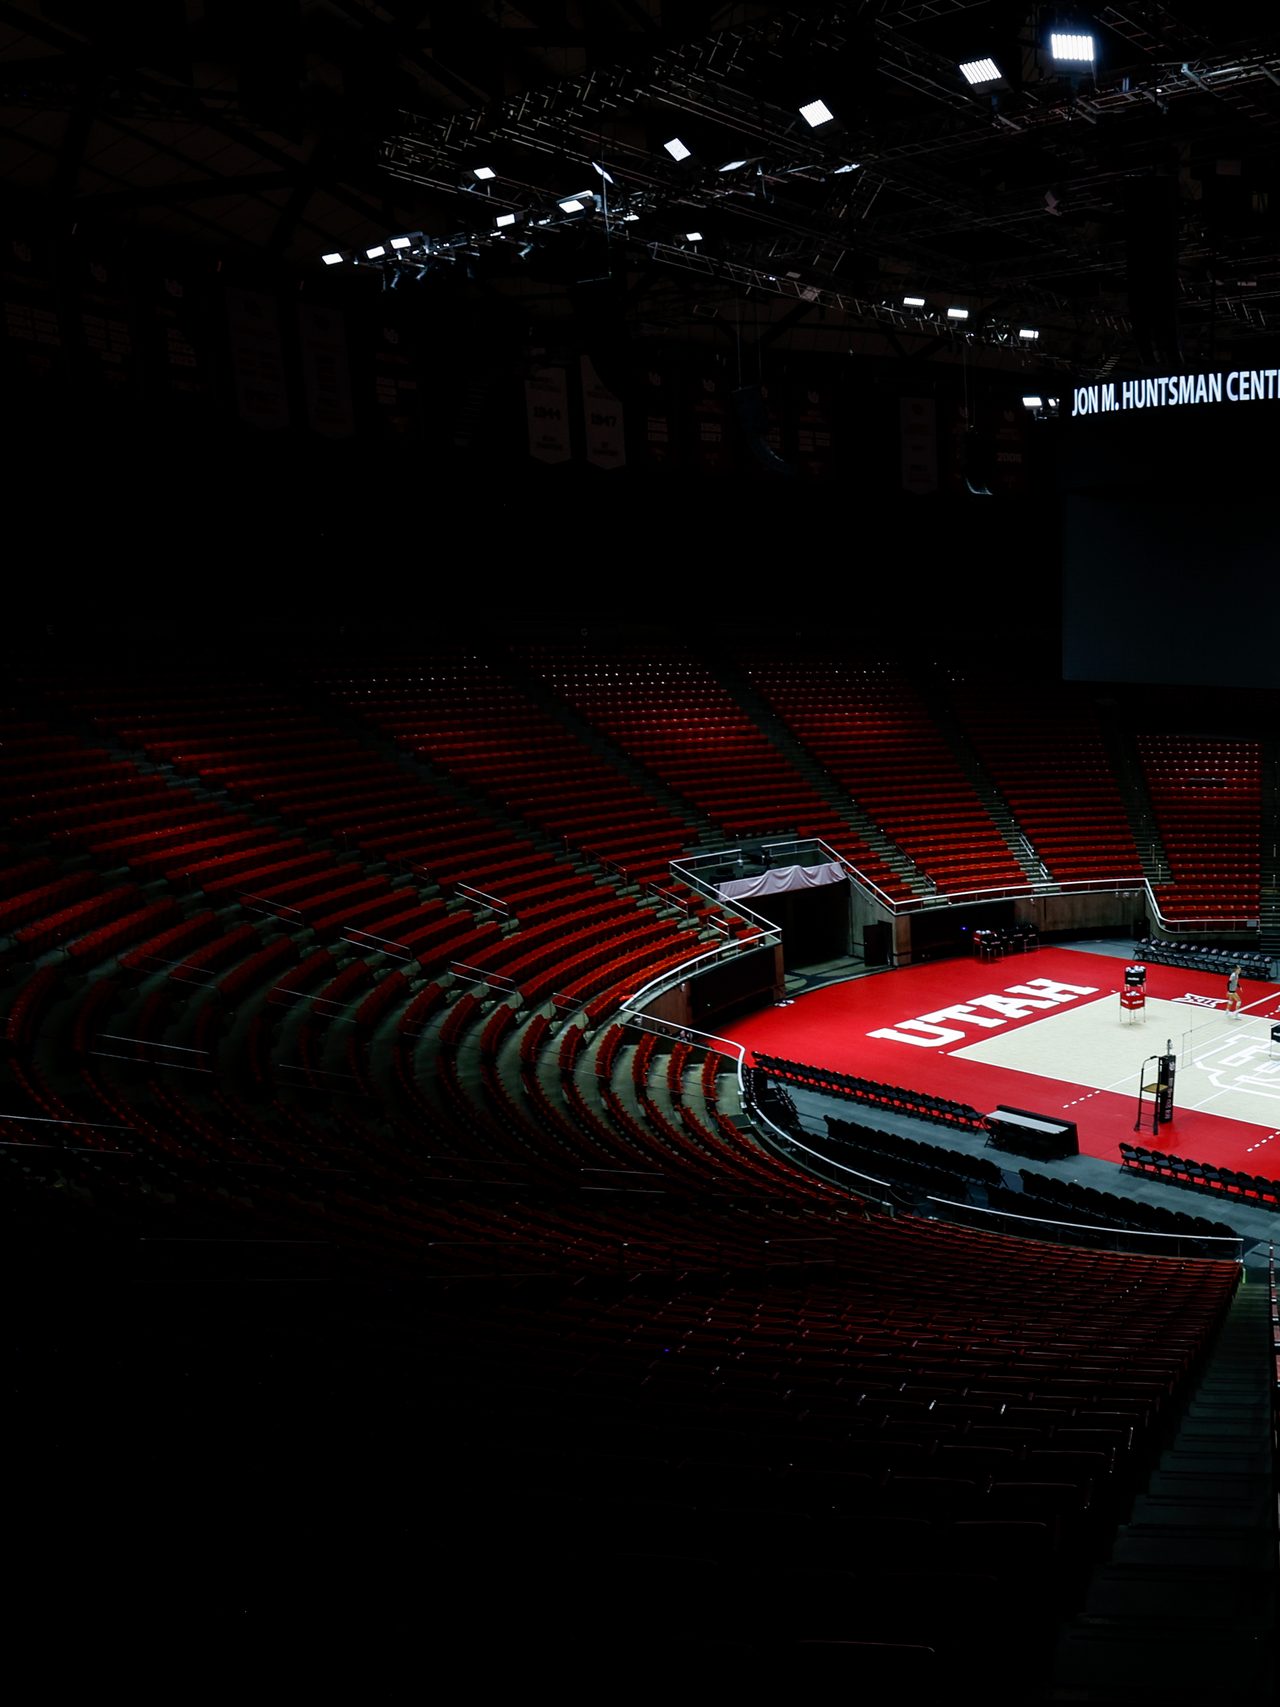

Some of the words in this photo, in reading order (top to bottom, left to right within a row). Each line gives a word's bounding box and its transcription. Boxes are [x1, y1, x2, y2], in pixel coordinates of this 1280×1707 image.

[1071, 386, 1098, 416] JON
[1102, 383, 1119, 412] M.
[1123, 373, 1222, 410] HUNTSMAN
[866, 978, 1100, 1047] UTAH
